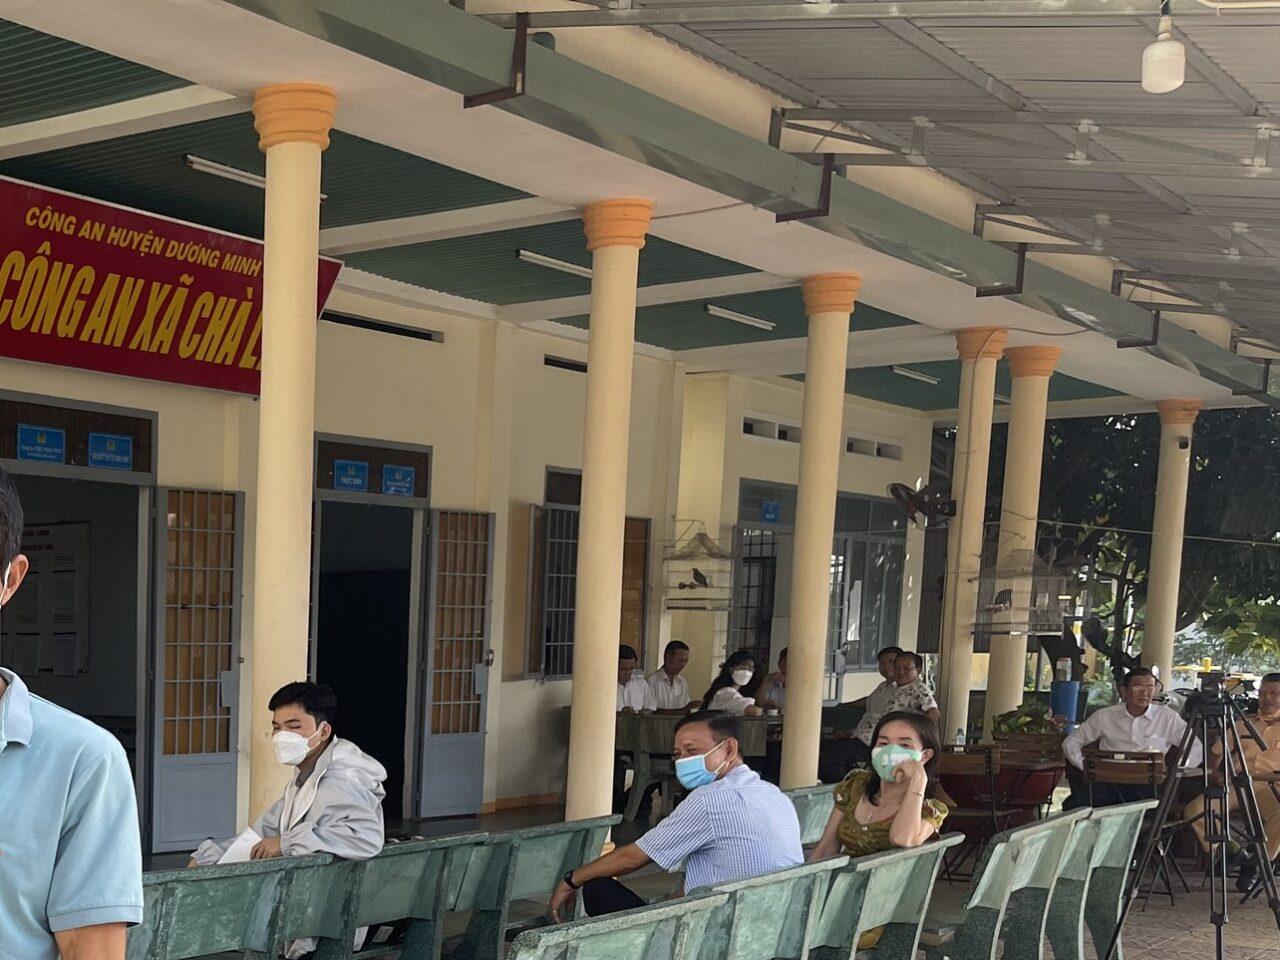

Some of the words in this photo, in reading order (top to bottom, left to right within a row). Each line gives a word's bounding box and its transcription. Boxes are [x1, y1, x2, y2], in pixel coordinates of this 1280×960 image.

[25, 205, 77, 235] CÔNG
[78, 220, 106, 242] AN
[107, 226, 165, 257] HUYỆN
[165, 239, 220, 268] DƯƠNG
[221, 253, 262, 277] MINH
[79, 273, 145, 347] AN
[129, 273, 195, 354] XÃ
[178, 287, 253, 365] CHÀ
[238, 309, 262, 371] L
